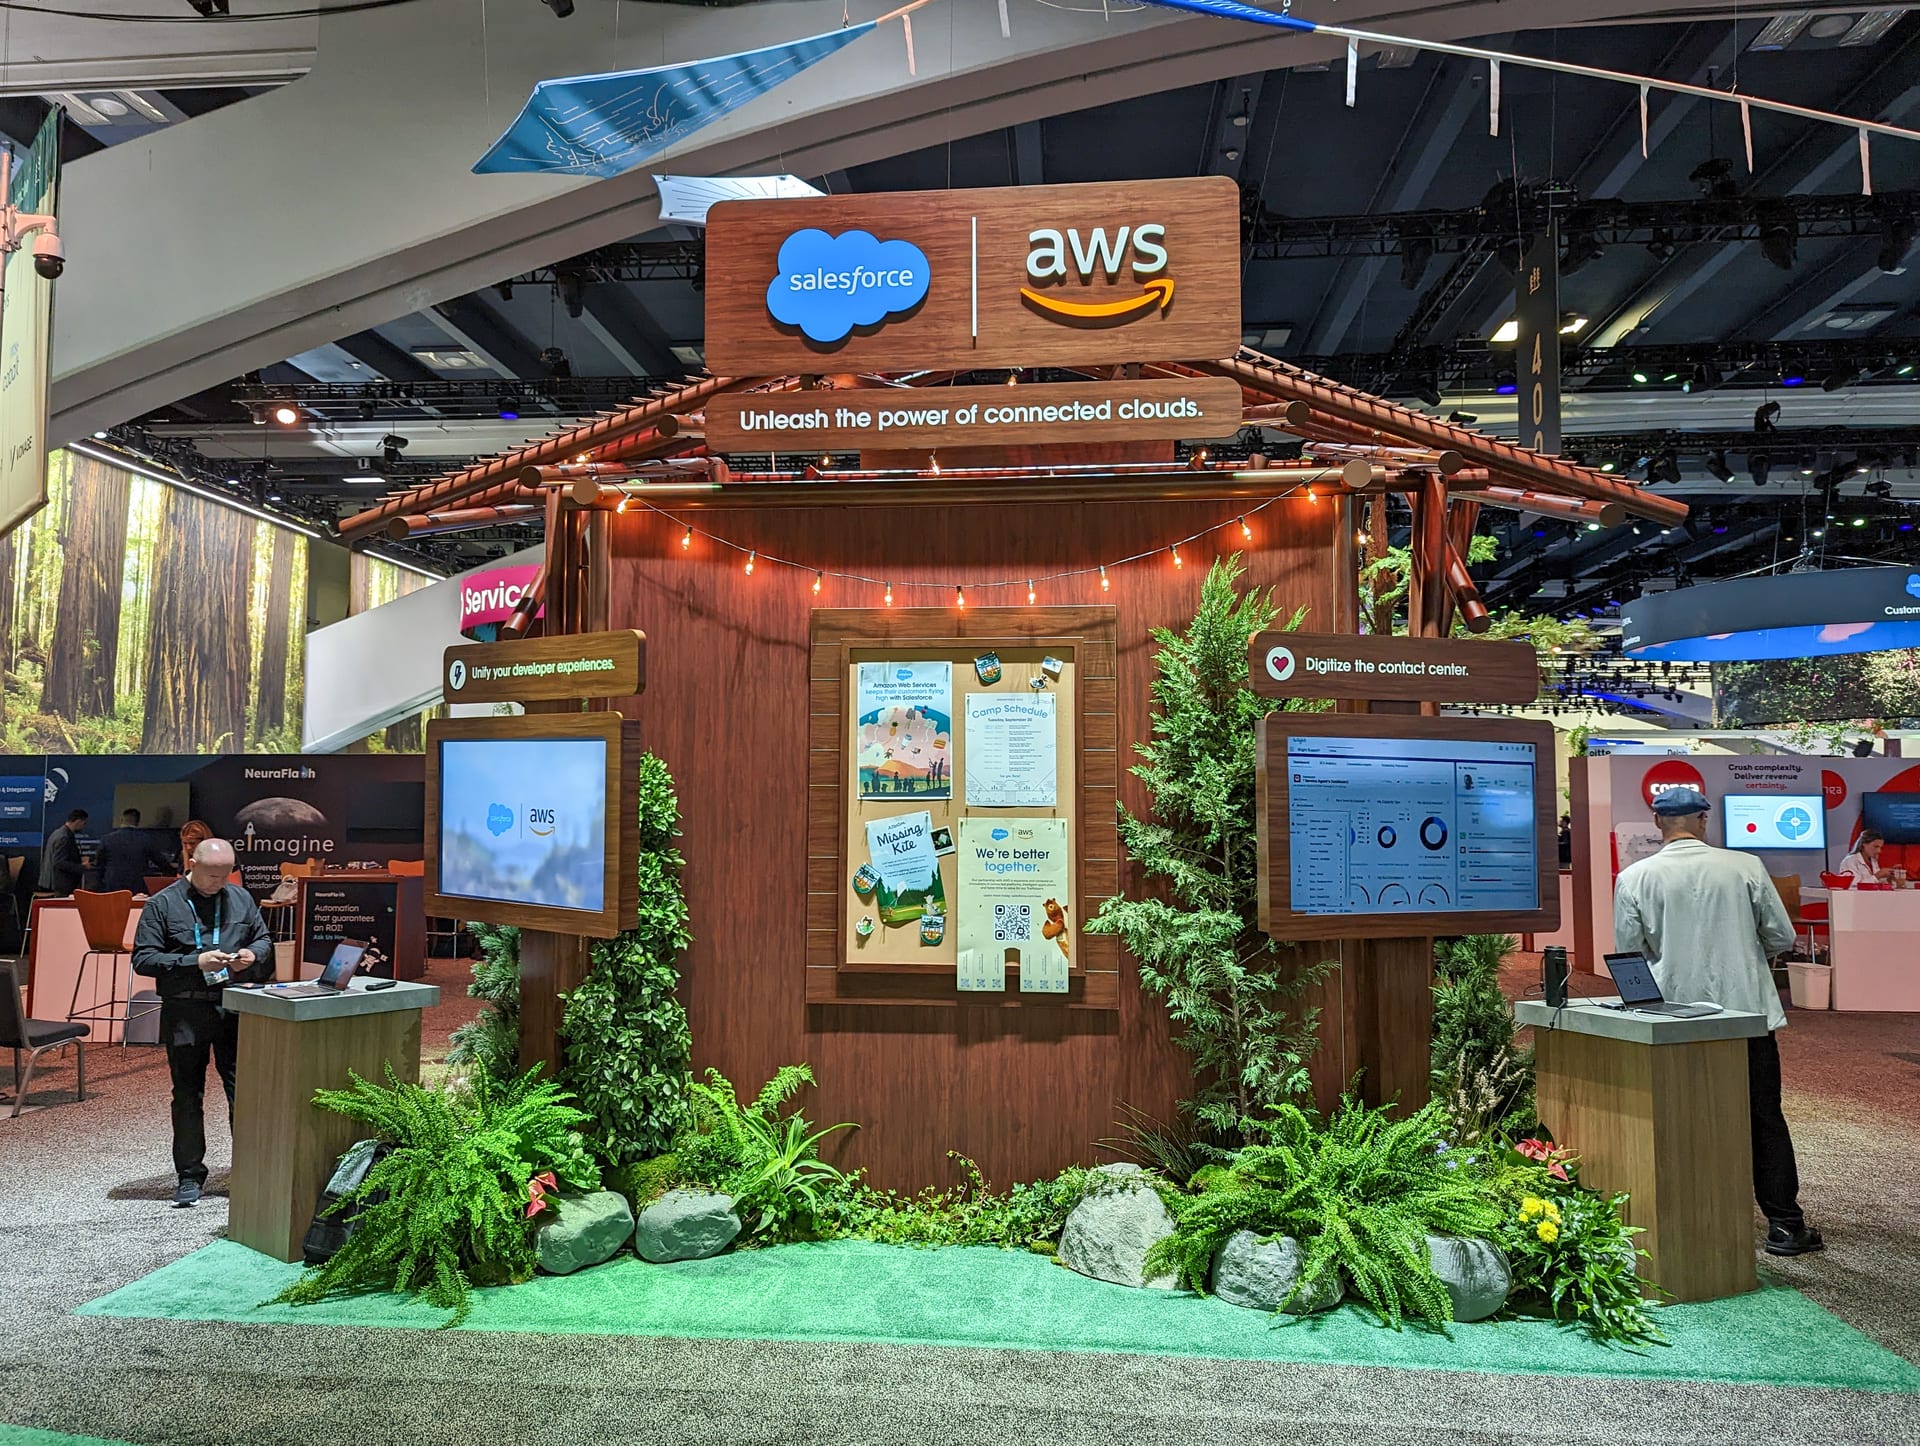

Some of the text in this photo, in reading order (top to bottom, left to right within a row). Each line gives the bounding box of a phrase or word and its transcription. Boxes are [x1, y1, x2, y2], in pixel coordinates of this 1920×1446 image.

[1025, 223, 1168, 278] aws
[790, 265, 914, 295] salesforce
[739, 397, 1204, 434] Unleash the power of connected clouds.
[471, 657, 616, 681] Unify your developer experiences.
[1305, 657, 1469, 676] Digitize the contact center.
[971, 704, 1049, 719] Camp Schedule
[1754, 764, 1803, 773] complexity.
[1745, 782, 1787, 791] certainty.
[529, 808, 555, 824] aws
[876, 824, 924, 847] Missing
[1017, 828, 1034, 836] aws
[891, 839, 917, 856] Kite
[975, 848, 1050, 859] We're better
[984, 861, 1040, 874] together.
[314, 903, 360, 912] Automation
[331, 915, 375, 923] guarantees
[325, 924, 343, 932] ROI!
